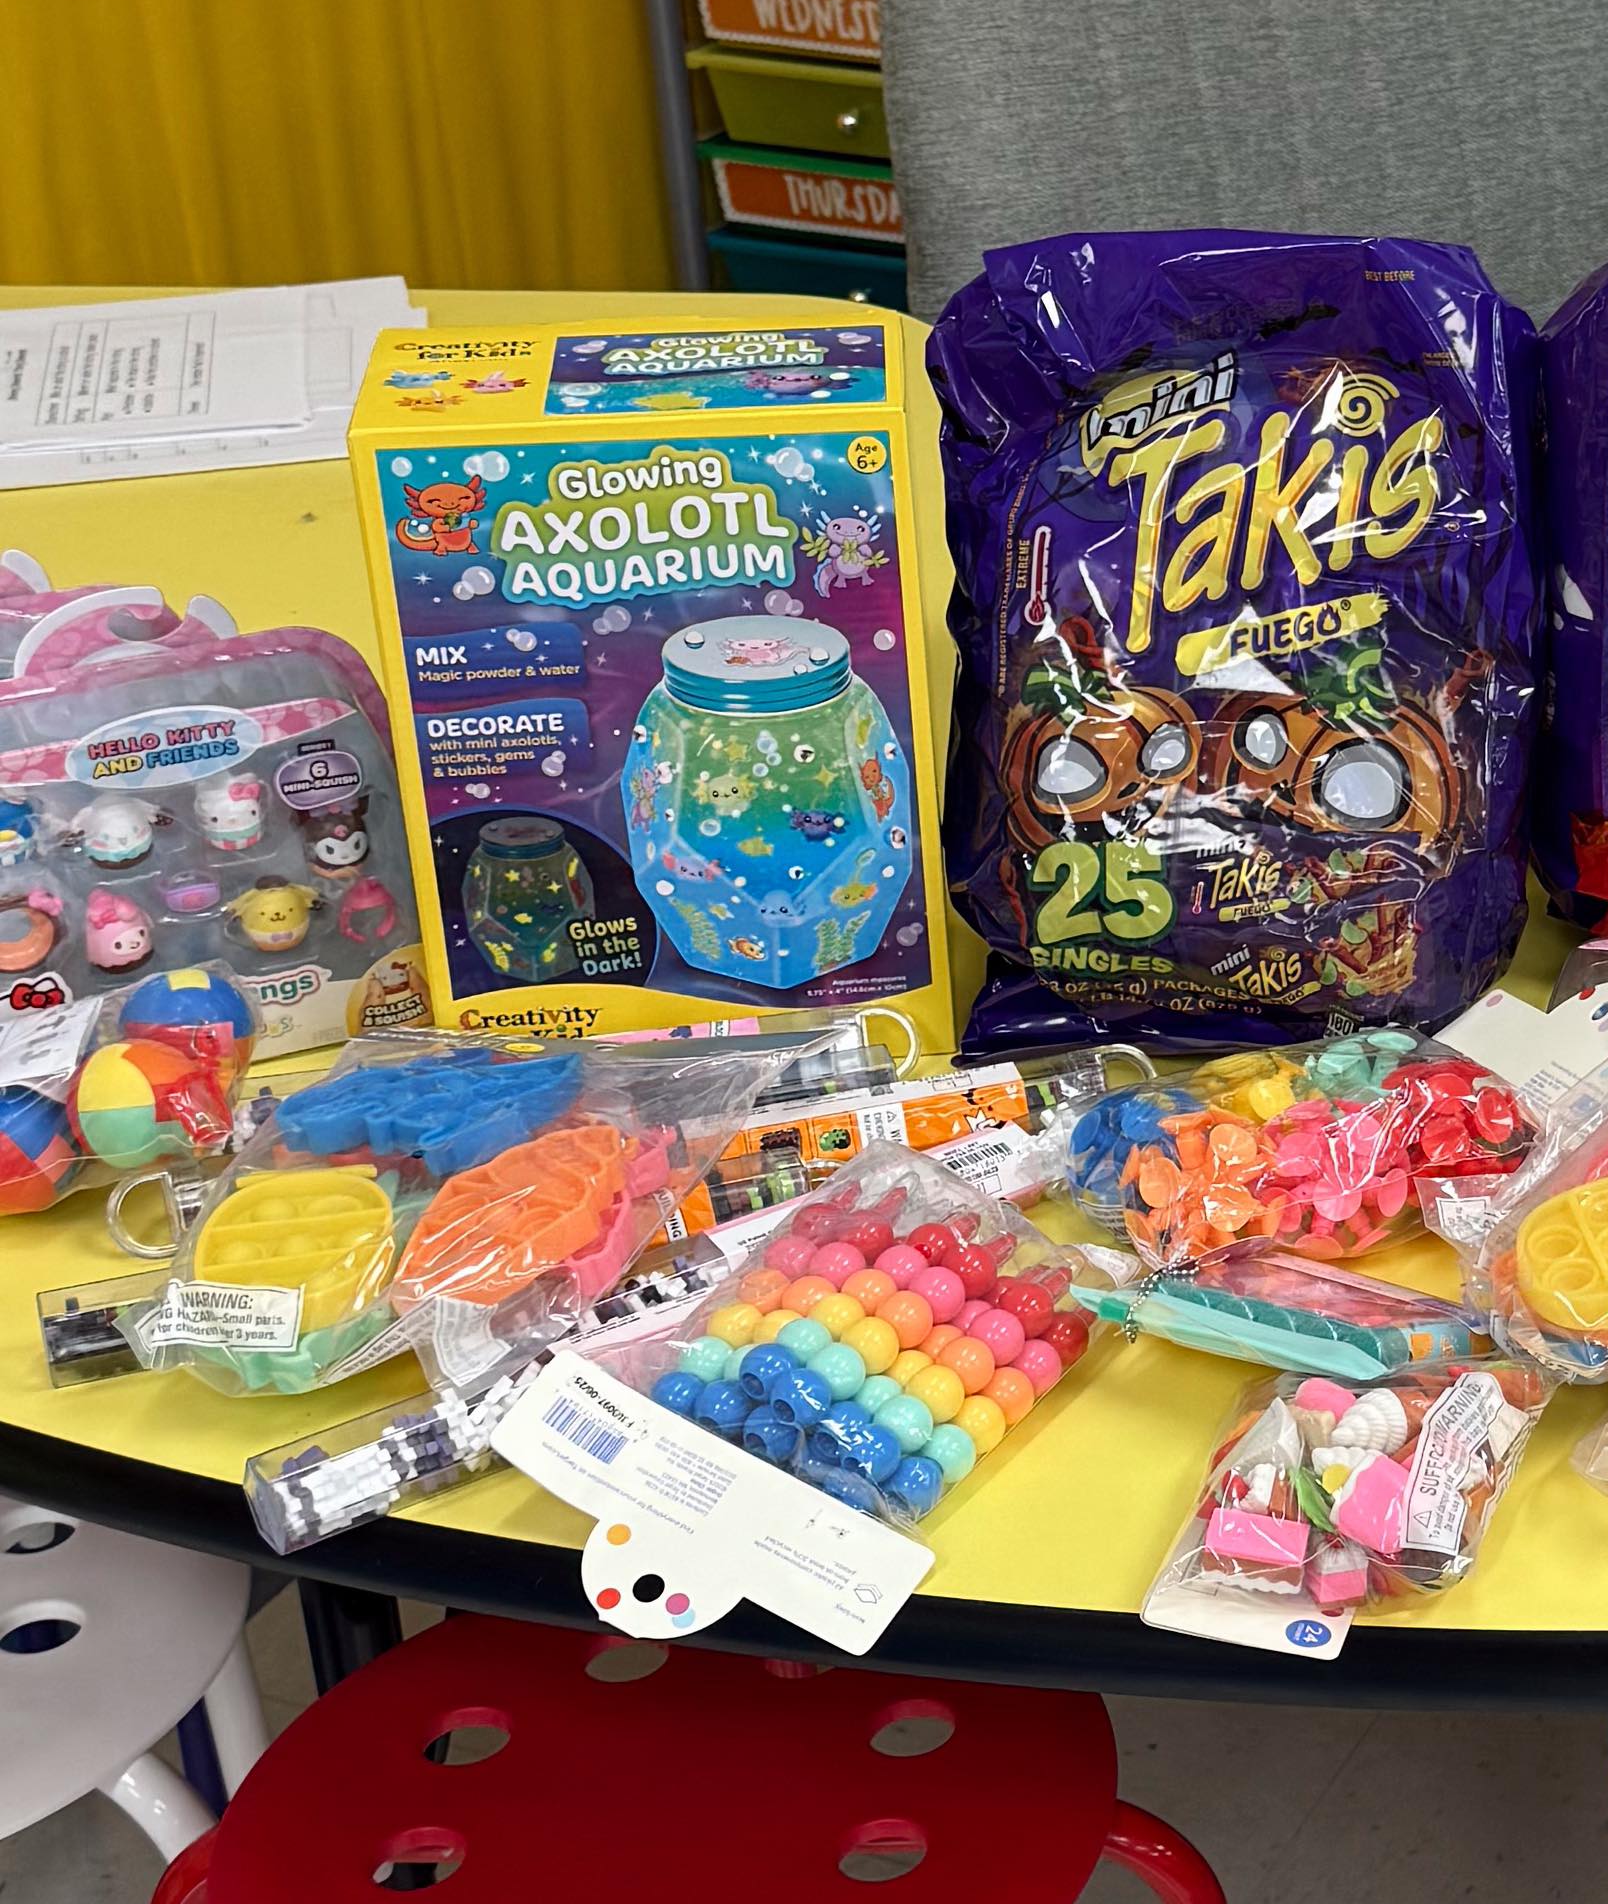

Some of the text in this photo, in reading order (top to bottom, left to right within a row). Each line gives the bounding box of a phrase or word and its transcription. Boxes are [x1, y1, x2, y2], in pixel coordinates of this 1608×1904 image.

[608, 340, 823, 363] AXOLOTL
[657, 333, 781, 348] Glowing
[464, 348, 532, 359] Kids
[610, 353, 817, 374] AQUARIUM
[853, 441, 880, 457] Age
[856, 453, 879, 471] 6+
[557, 455, 724, 500] Glowing
[500, 491, 790, 556] AXOLOTL
[1107, 396, 1444, 653] Takis
[509, 543, 786, 601] AQUARIUM
[1015, 538, 1031, 590] EXTREME
[1229, 606, 1343, 656] FUEGO
[414, 645, 469, 667] MIX
[418, 663, 581, 683] Magic powder water
[427, 712, 565, 738] DECORATE
[87, 719, 237, 761] HELLO KITTY
[429, 736, 497, 752] with mini
[92, 738, 240, 780] AND FRIENDS
[309, 761, 329, 780] 6
[447, 763, 508, 778] bubbles
[1032, 841, 1176, 945] 25
[568, 916, 638, 941] Glows
[575, 935, 641, 958] in the
[582, 951, 643, 977] Dark!
[1029, 945, 1176, 976] SINGLES
[365, 994, 422, 1017] COLLECT
[458, 1004, 602, 1030] Creativity
